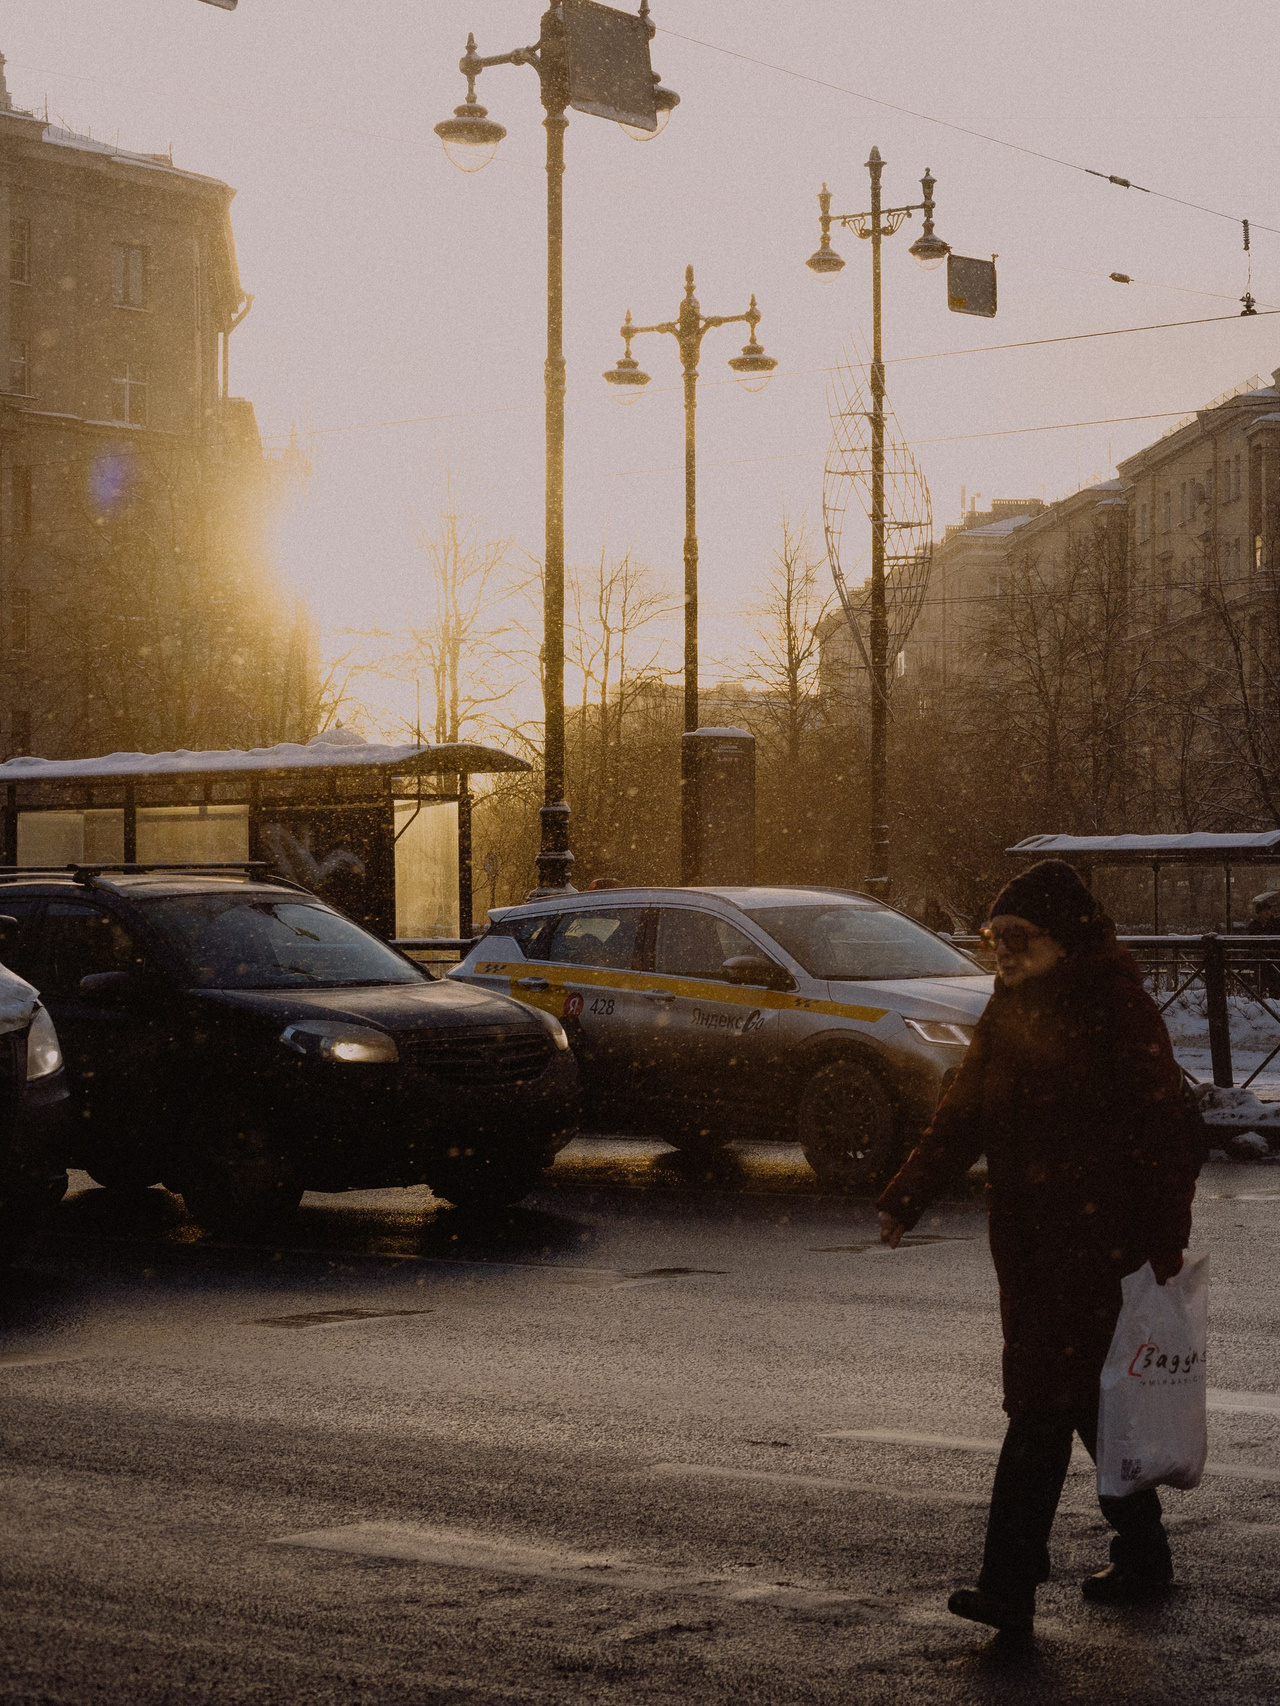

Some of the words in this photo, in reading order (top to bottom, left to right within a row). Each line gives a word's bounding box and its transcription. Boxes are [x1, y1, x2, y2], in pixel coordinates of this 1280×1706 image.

[589, 998, 615, 1016] 428
[691, 1007, 744, 1029] Яндекс
[742, 1009, 765, 1033] Go
